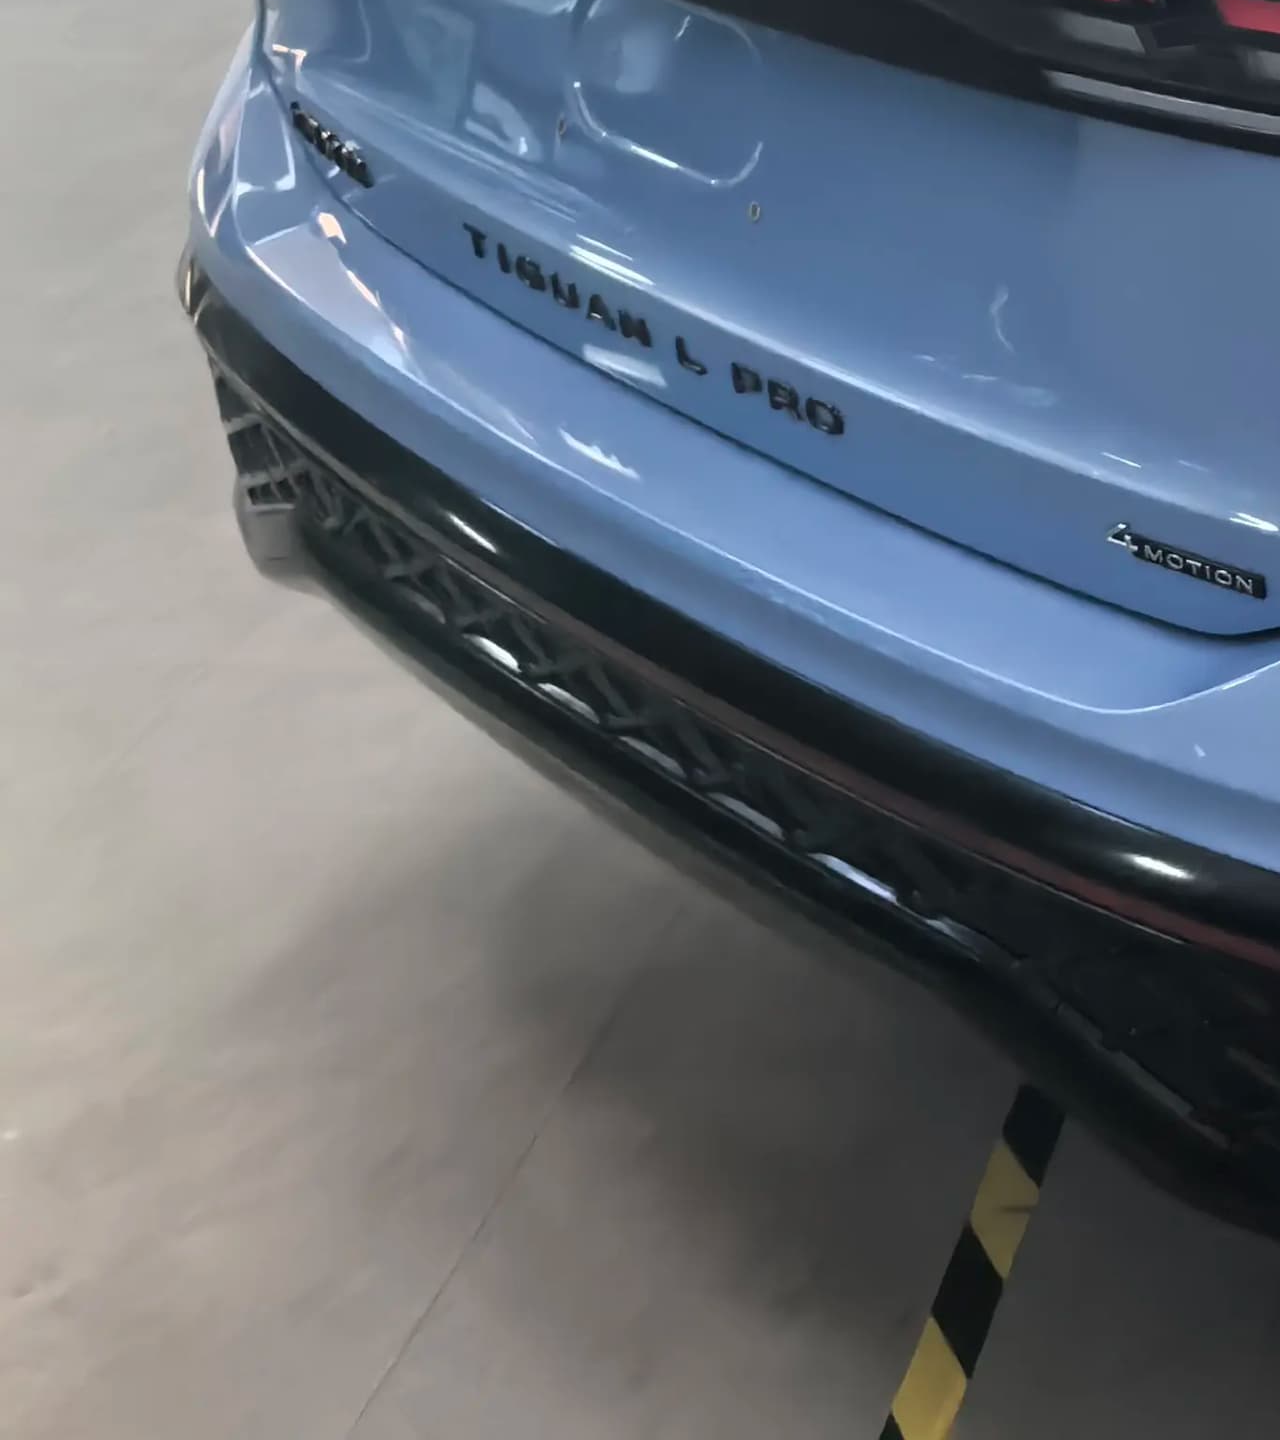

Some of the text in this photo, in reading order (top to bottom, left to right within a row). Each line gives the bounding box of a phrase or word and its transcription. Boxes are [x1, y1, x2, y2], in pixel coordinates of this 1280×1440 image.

[462, 222, 845, 436] TIGUAN L PRO
